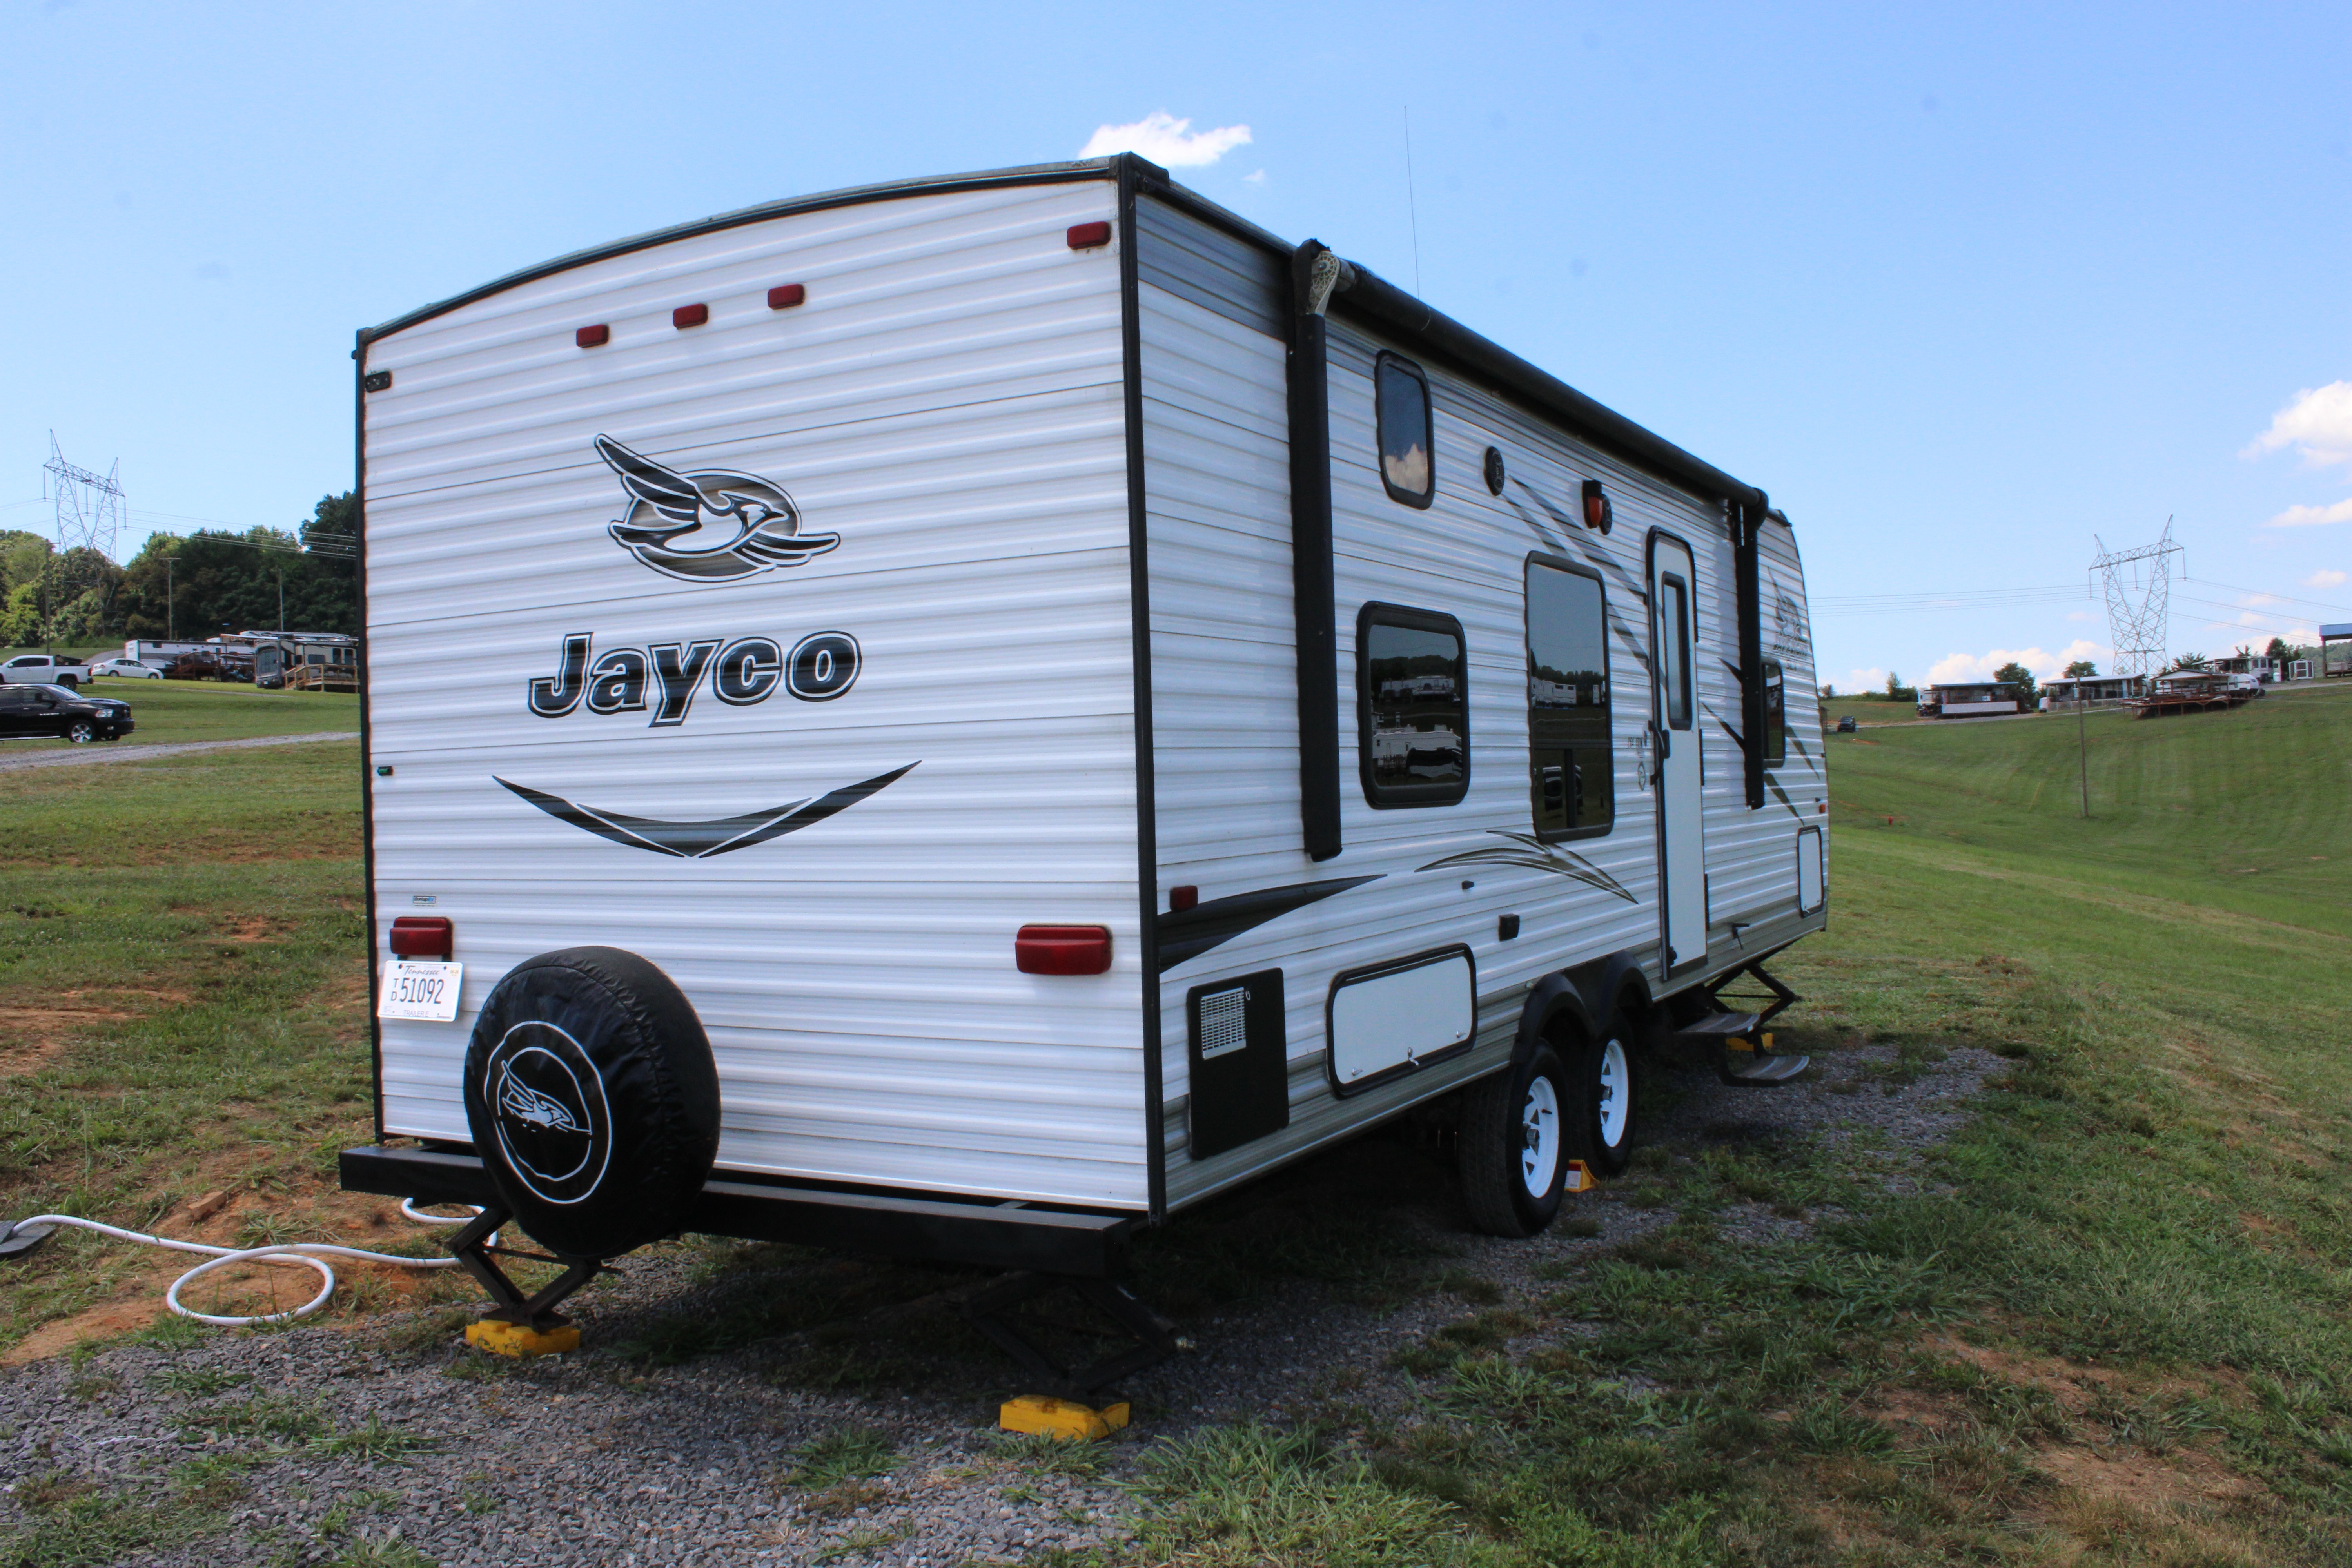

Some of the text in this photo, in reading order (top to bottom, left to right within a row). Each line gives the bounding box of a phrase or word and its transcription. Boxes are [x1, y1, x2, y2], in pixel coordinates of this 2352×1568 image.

[529, 631, 862, 728] Jayco
[404, 965, 440, 976] Tennessee
[400, 977, 445, 1004] 51092
